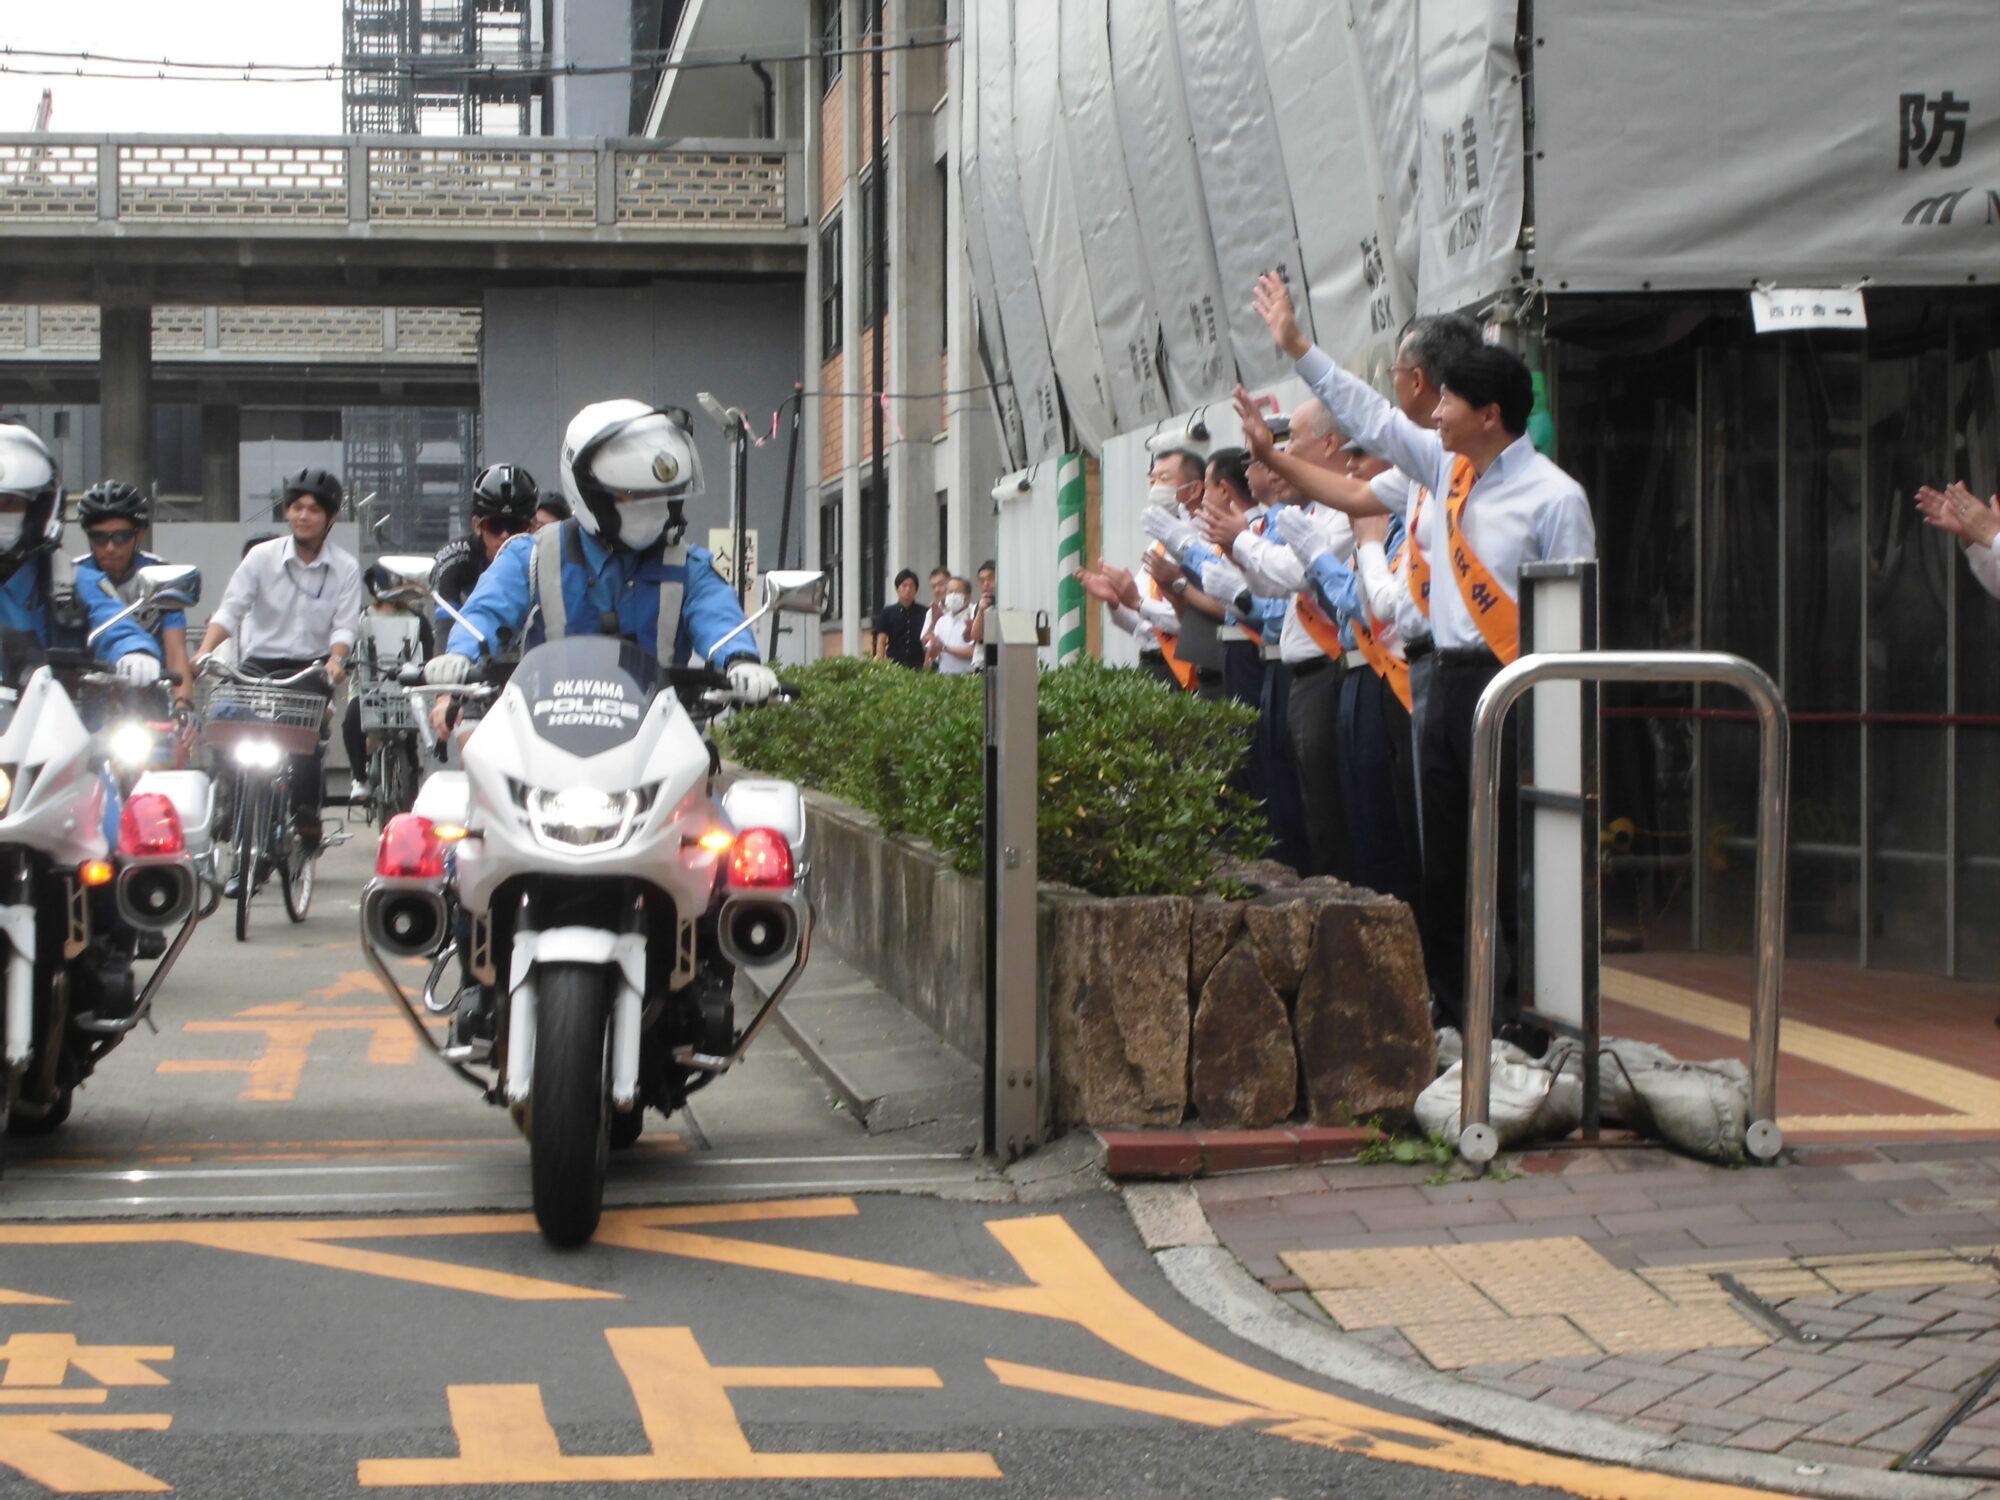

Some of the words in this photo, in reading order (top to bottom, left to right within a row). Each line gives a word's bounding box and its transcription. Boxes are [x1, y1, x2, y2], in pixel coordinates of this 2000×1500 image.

[1898, 90, 1970, 170] 防
[552, 680, 624, 700] OKAYAMA
[533, 697, 640, 720] POLICE
[547, 712, 625, 729] HONDA
